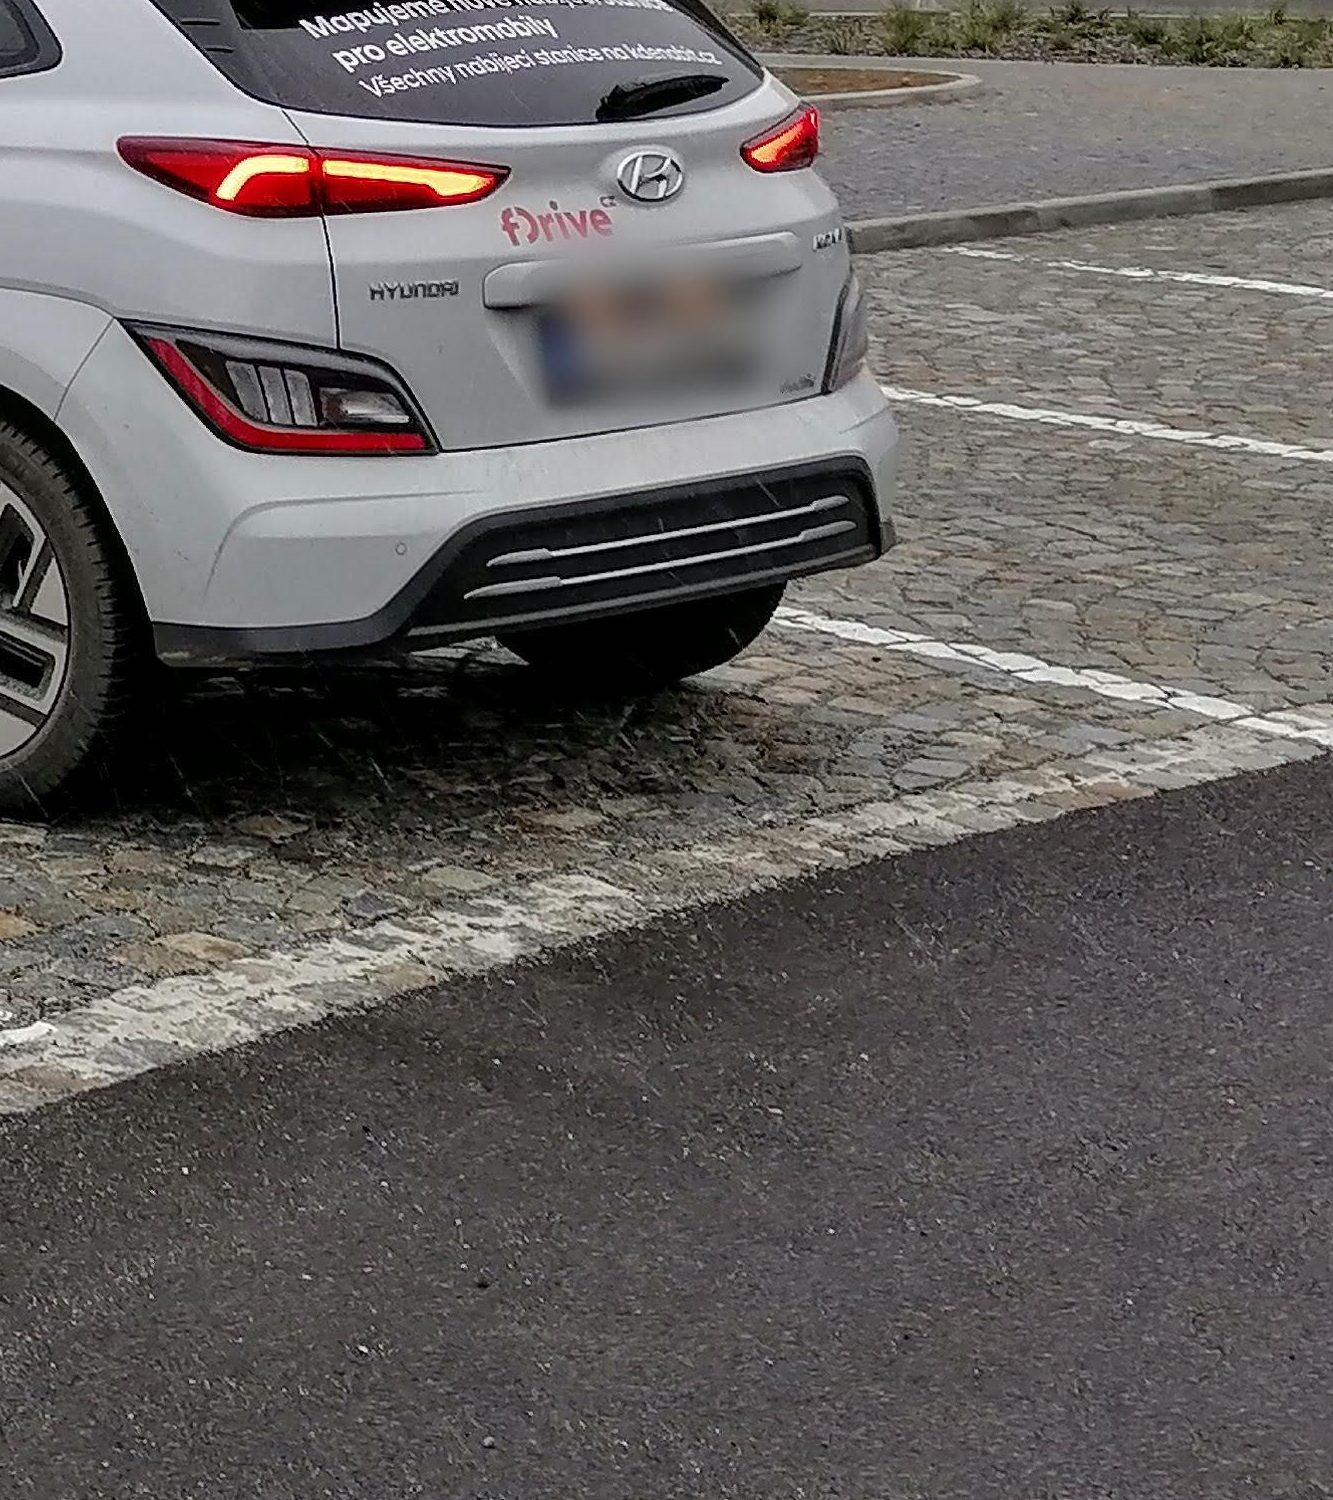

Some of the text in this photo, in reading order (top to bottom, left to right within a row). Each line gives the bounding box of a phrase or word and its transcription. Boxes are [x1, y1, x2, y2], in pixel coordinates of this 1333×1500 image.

[298, 1, 451, 40] Mapujeme
[331, 15, 559, 74] pro elektromobily
[358, 64, 457, 98] Všechny
[454, 48, 536, 75] nabíjecí
[533, 44, 604, 66] stanice
[600, 46, 630, 61] na
[369, 280, 460, 301] HYUNDAI
